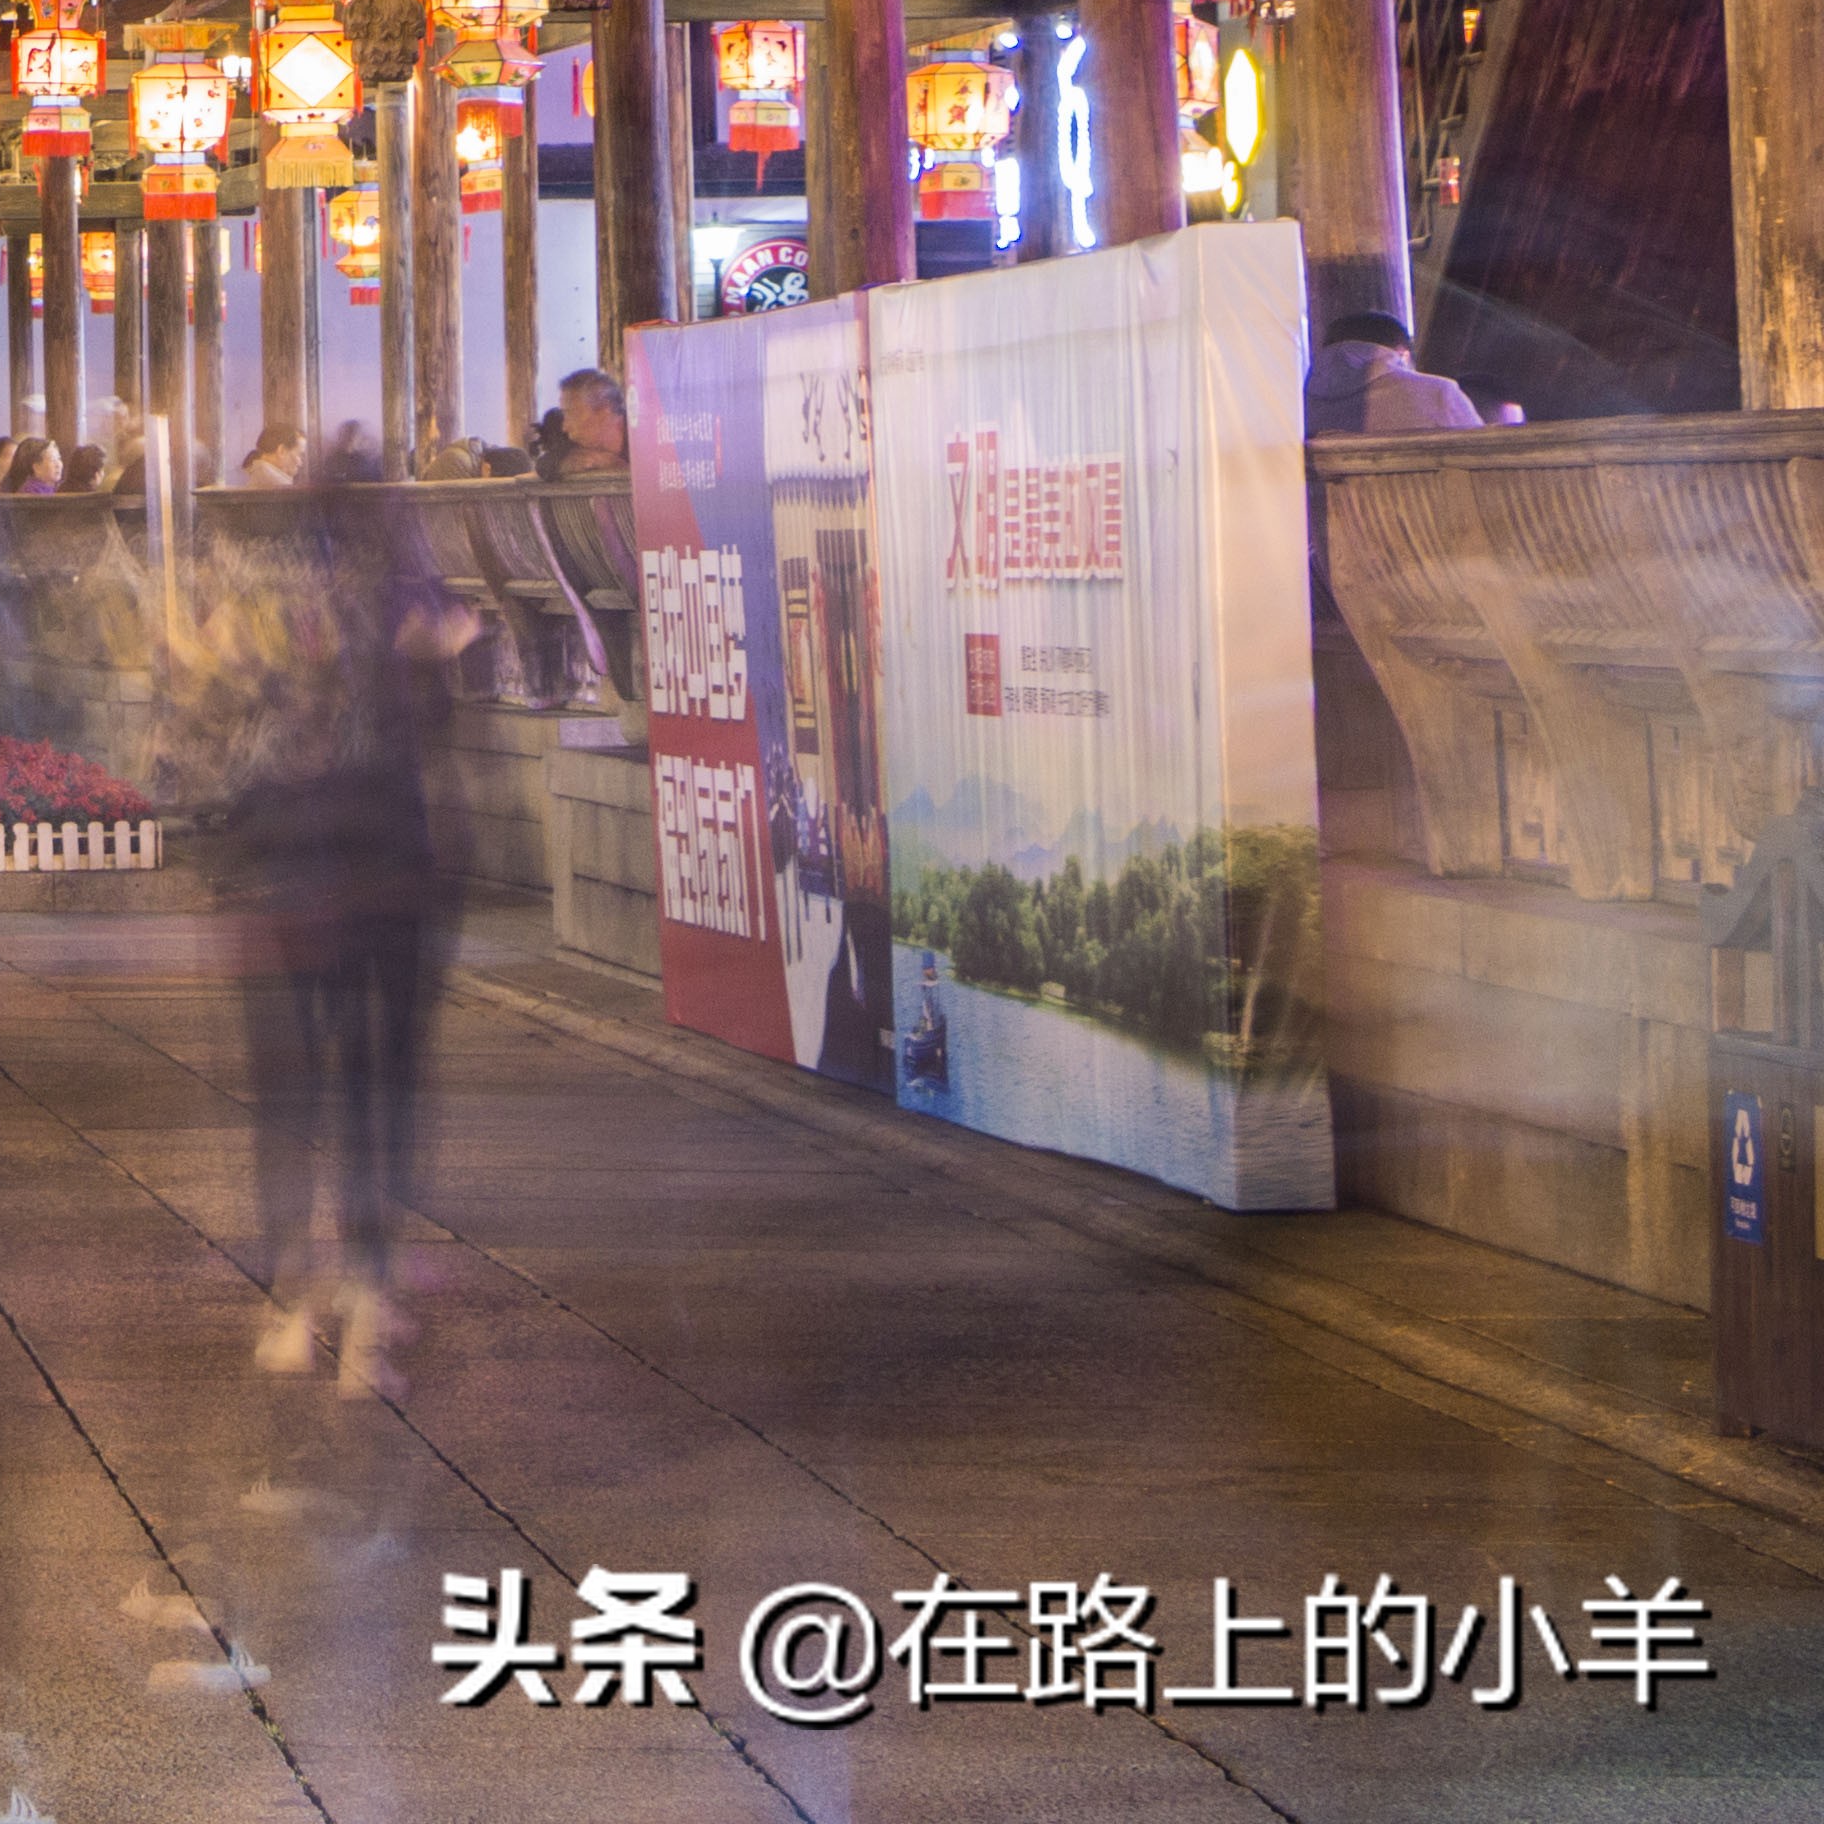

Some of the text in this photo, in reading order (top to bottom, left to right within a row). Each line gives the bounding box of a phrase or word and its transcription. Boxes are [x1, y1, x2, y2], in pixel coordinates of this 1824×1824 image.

[725, 248, 775, 305] MAAN
[945, 426, 1124, 594] 文明是最美的风景
